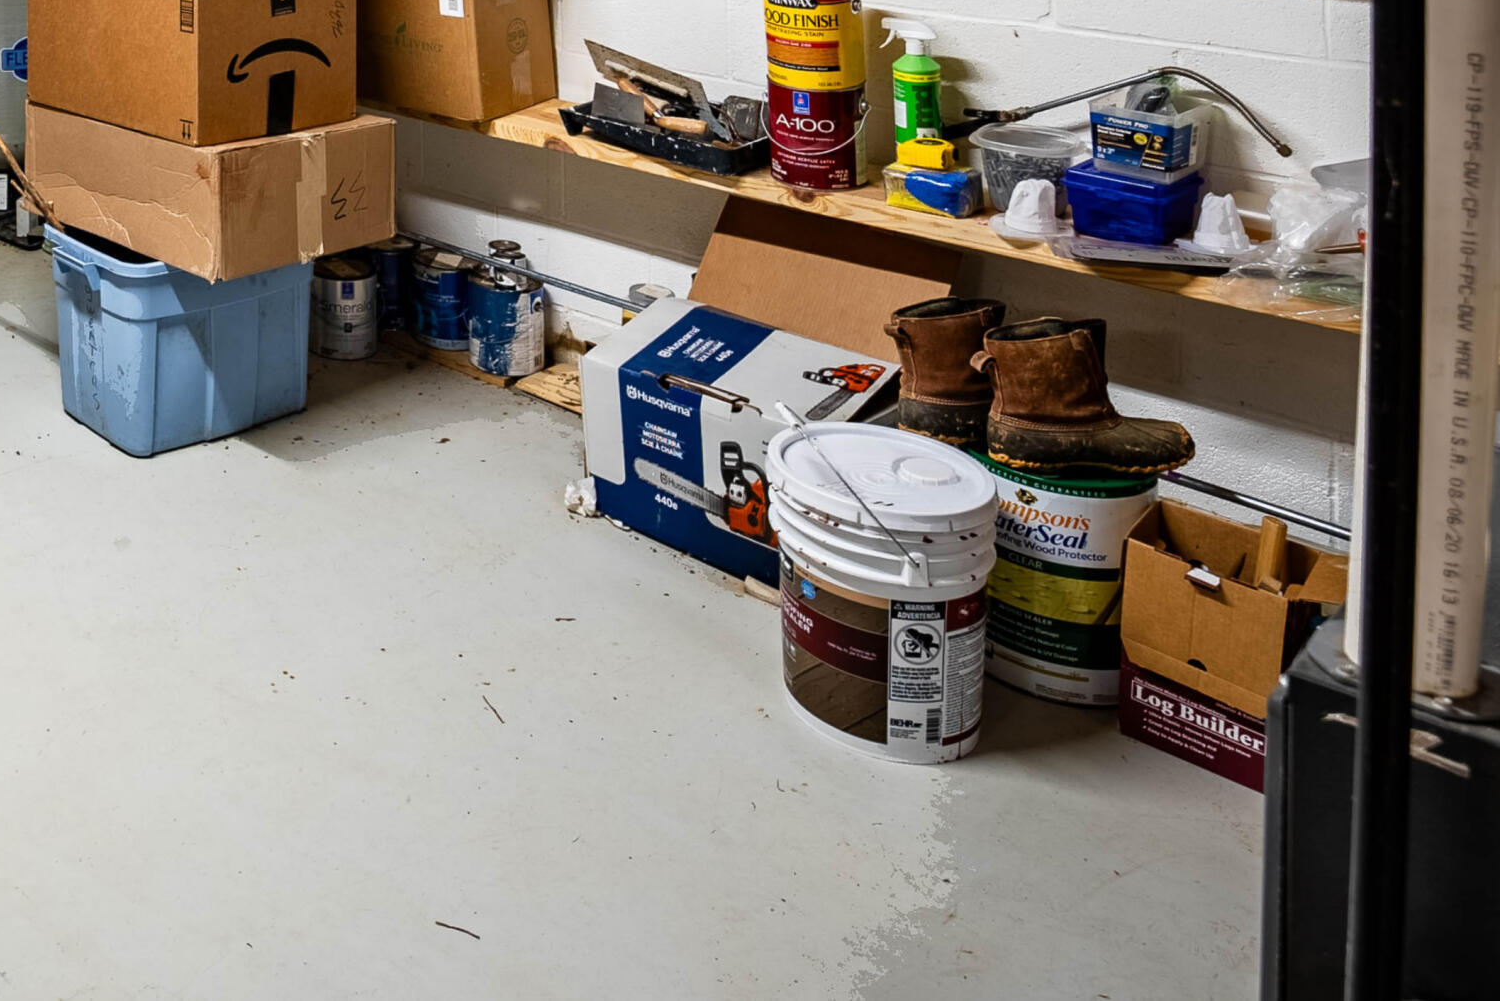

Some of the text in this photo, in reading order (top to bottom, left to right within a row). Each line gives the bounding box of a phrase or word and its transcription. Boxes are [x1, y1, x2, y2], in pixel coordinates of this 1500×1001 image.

[765, 6, 839, 28] OOD FINISH
[775, 113, 835, 134] A-100
[1454, 339, 1474, 382] MADE
[636, 389, 692, 418] Husqvarna
[1452, 388, 1472, 408] IN
[654, 492, 679, 511] 440e
[995, 514, 1089, 550] aterSeal
[1007, 551, 1044, 571] CLEAR
[1024, 539, 1057, 557] Wood
[1056, 546, 1109, 563] Protector
[889, 718, 914, 728] BEHR
[1135, 684, 1175, 717] Log
[1180, 704, 1264, 751] Builder
